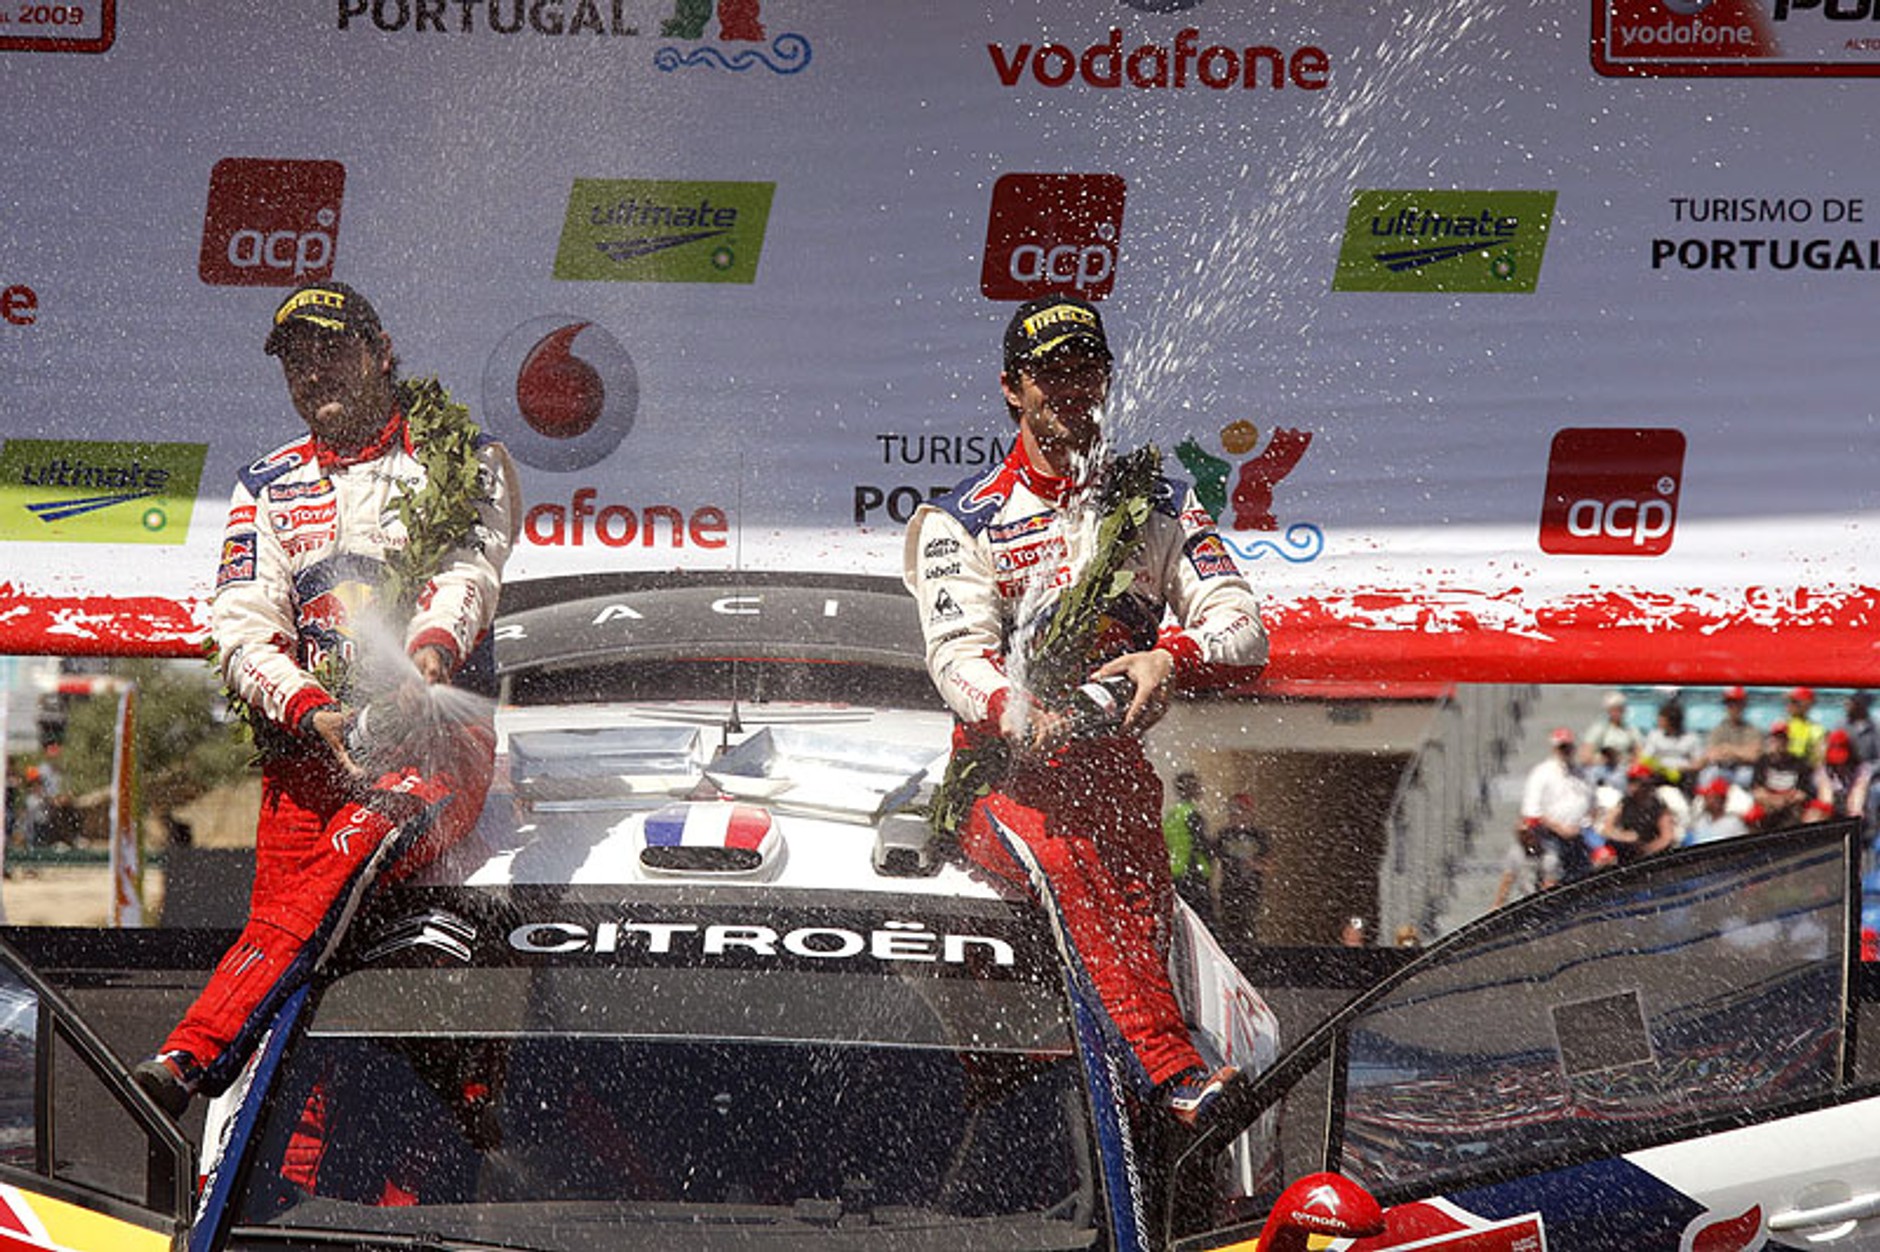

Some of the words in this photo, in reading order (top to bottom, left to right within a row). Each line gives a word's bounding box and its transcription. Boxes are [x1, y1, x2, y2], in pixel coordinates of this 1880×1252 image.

[18, 5, 84, 26] 2009
[337, 0, 639, 36] PORTUGAL
[1620, 19, 1753, 45] vodafone
[986, 27, 1331, 91] vodafone
[590, 199, 738, 228] ultimate
[1371, 208, 1519, 237] ultimate
[1669, 197, 1813, 223] TURISMO
[1823, 198, 1863, 223] DE
[227, 229, 332, 276] acp
[1009, 244, 1112, 290] acp
[1651, 238, 1880, 270] PORTUGAL
[22, 459, 170, 489] ultimate
[514, 487, 729, 549] afone
[1567, 499, 1673, 546] acp
[508, 919, 1015, 967] CITROËN
